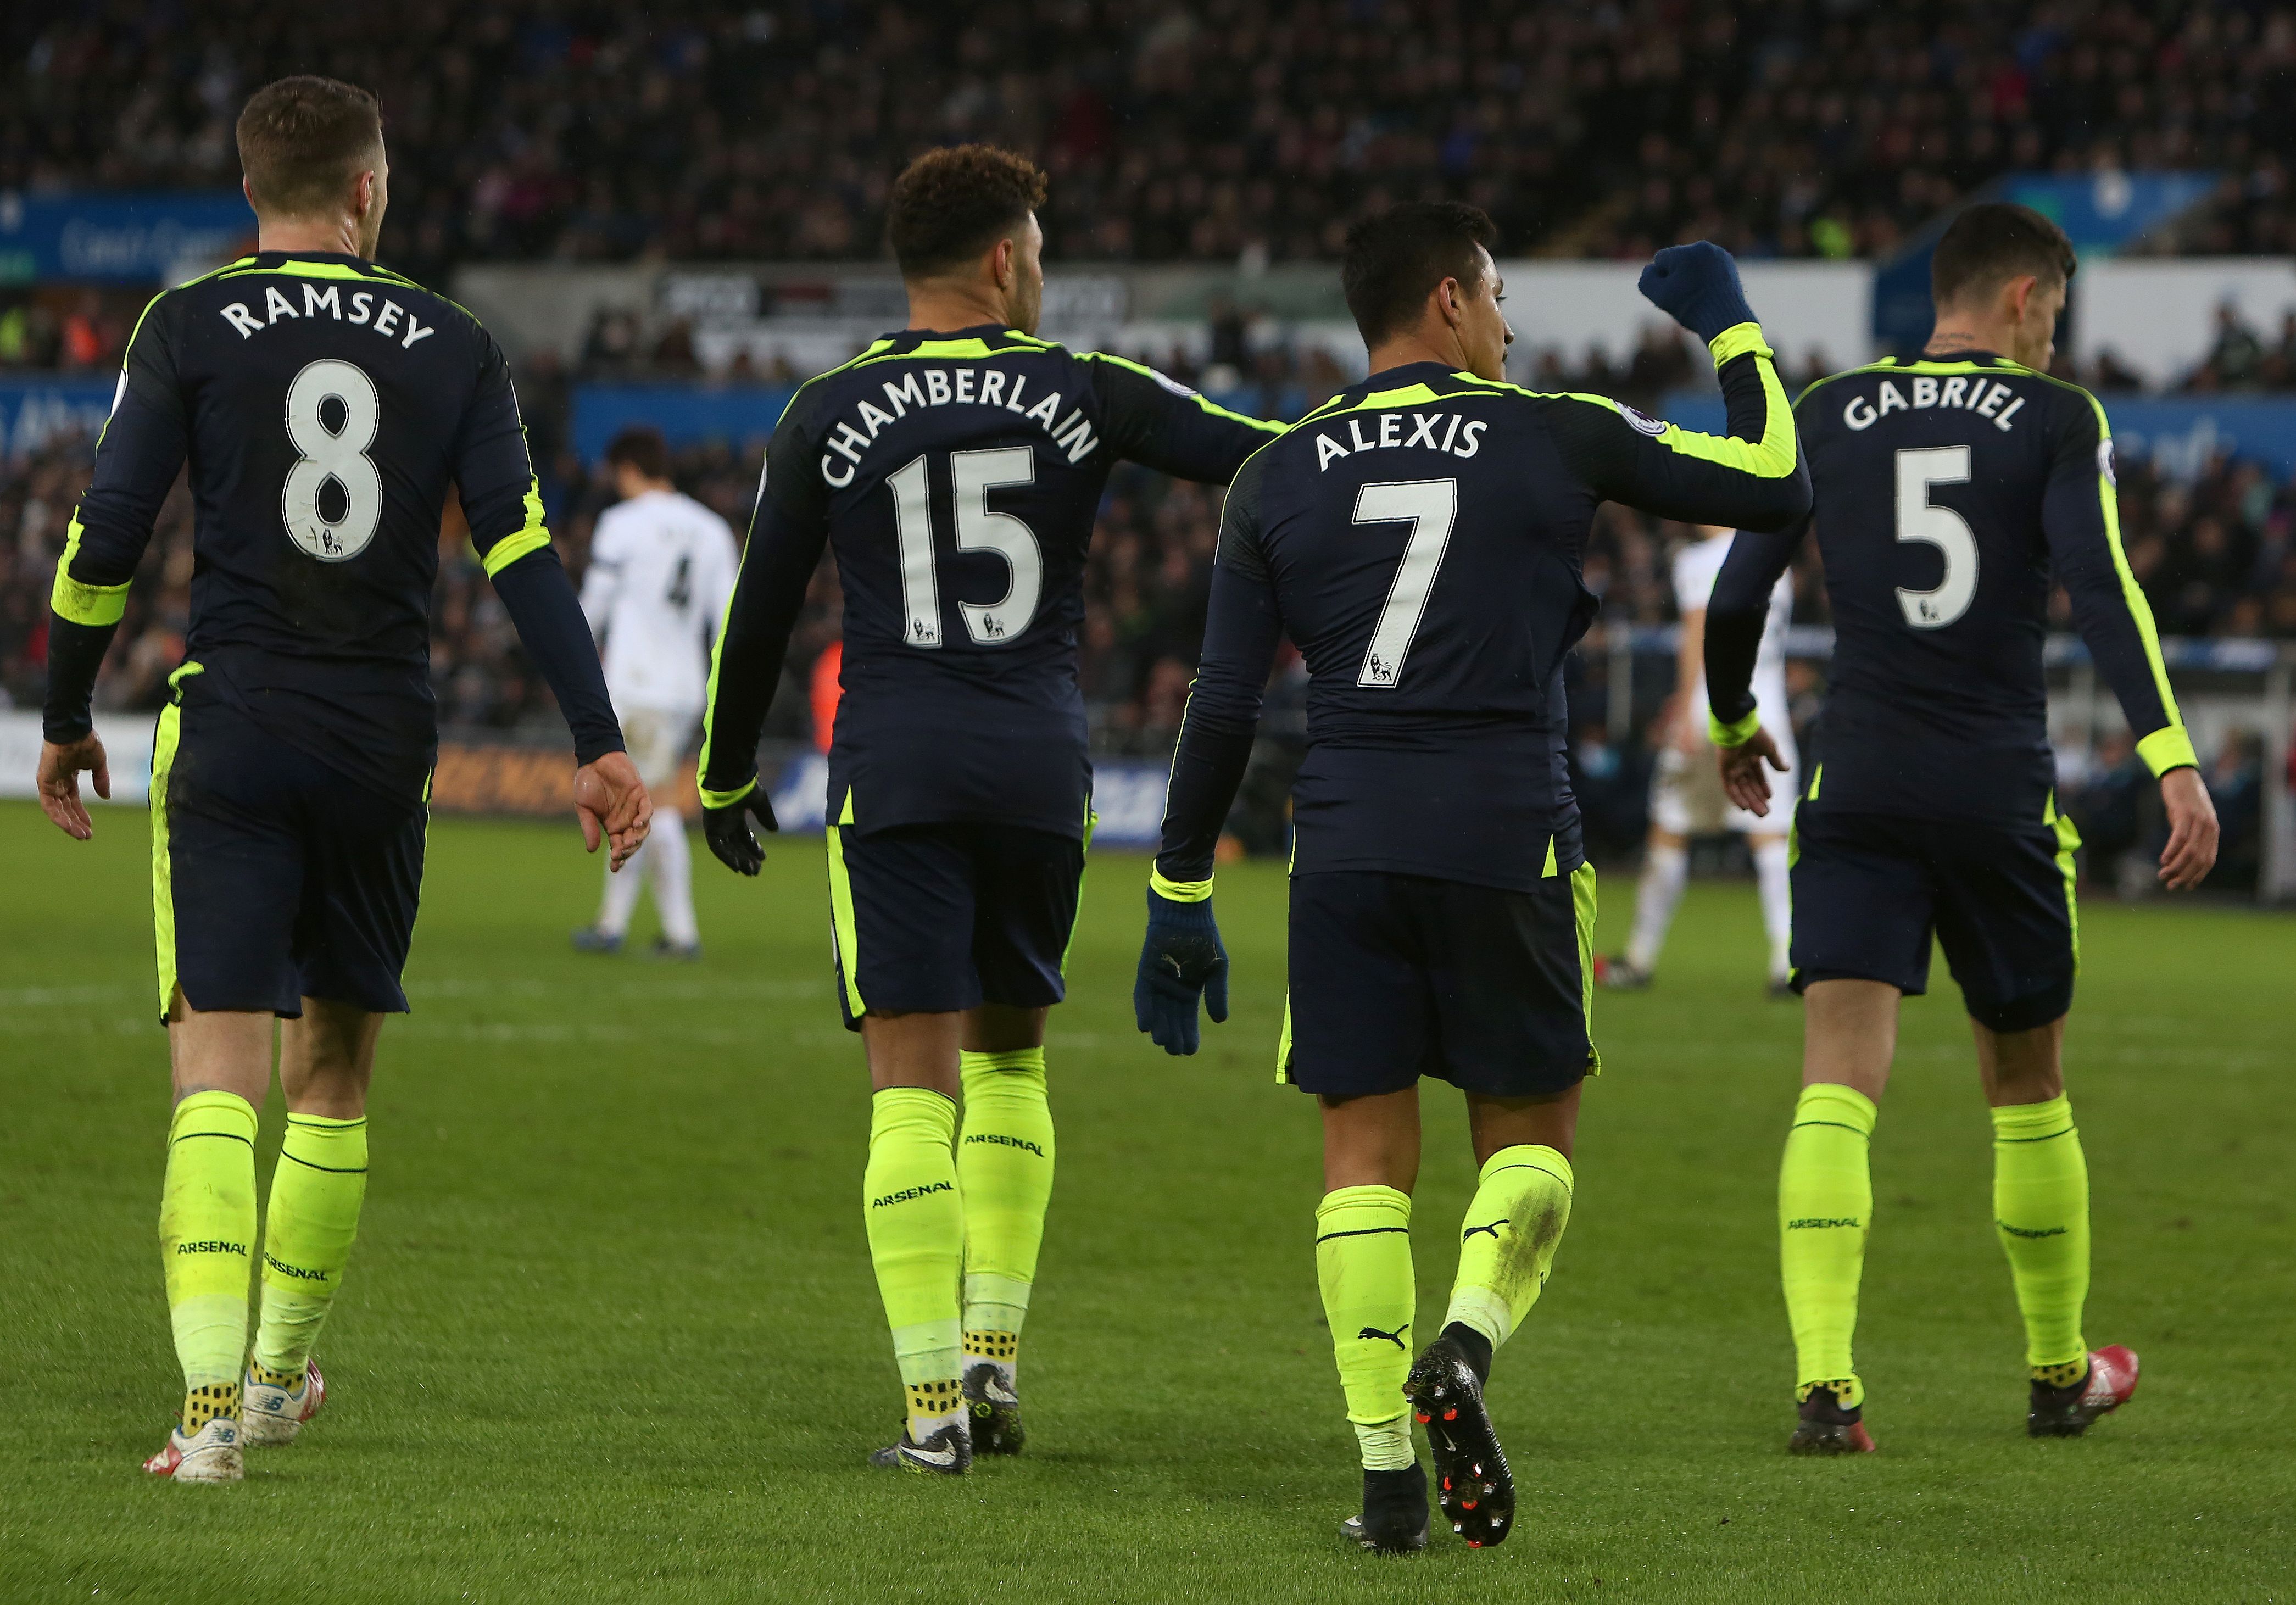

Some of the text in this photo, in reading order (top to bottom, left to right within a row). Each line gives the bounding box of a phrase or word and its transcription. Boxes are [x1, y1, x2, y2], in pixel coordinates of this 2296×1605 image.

[220, 283, 435, 349] RAMSEY
[821, 368, 1099, 489] CHAMBERLAIN
[1843, 376, 2026, 433] GABRIEL
[281, 358, 382, 563] 8
[1316, 413, 1489, 472] ALEXIS
[885, 445, 1044, 649] 15
[1894, 445, 1980, 631] 5
[1351, 477, 1457, 689] 7
[965, 1134, 1045, 1158] ARSENAL
[872, 1180, 955, 1210] ARSENAL
[1788, 1218, 1862, 1231] ARSENAL
[177, 1241, 247, 1257] ARSENAL
[264, 1250, 328, 1281] ARSENAL
